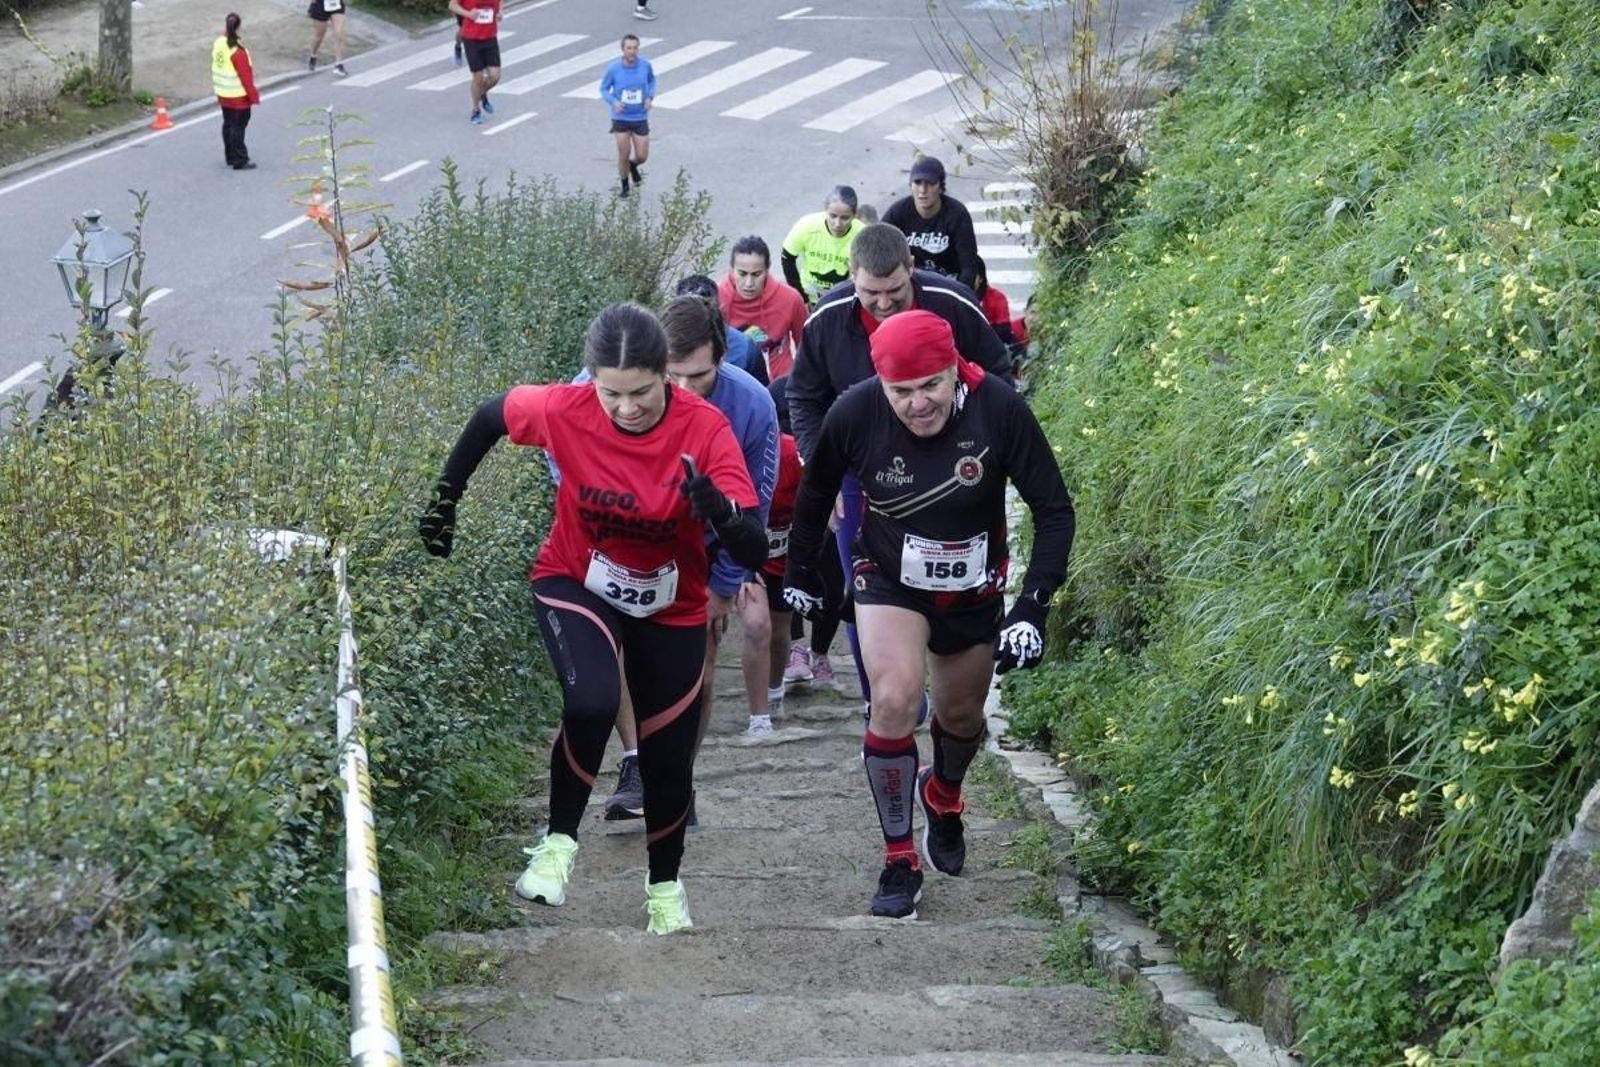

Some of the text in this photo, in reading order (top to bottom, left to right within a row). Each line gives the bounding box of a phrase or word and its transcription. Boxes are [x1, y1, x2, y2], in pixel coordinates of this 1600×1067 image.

[885, 472, 914, 486] Trigal
[578, 485, 640, 514] VIGO,
[924, 561, 968, 579] 158
[604, 581, 657, 606] 328
